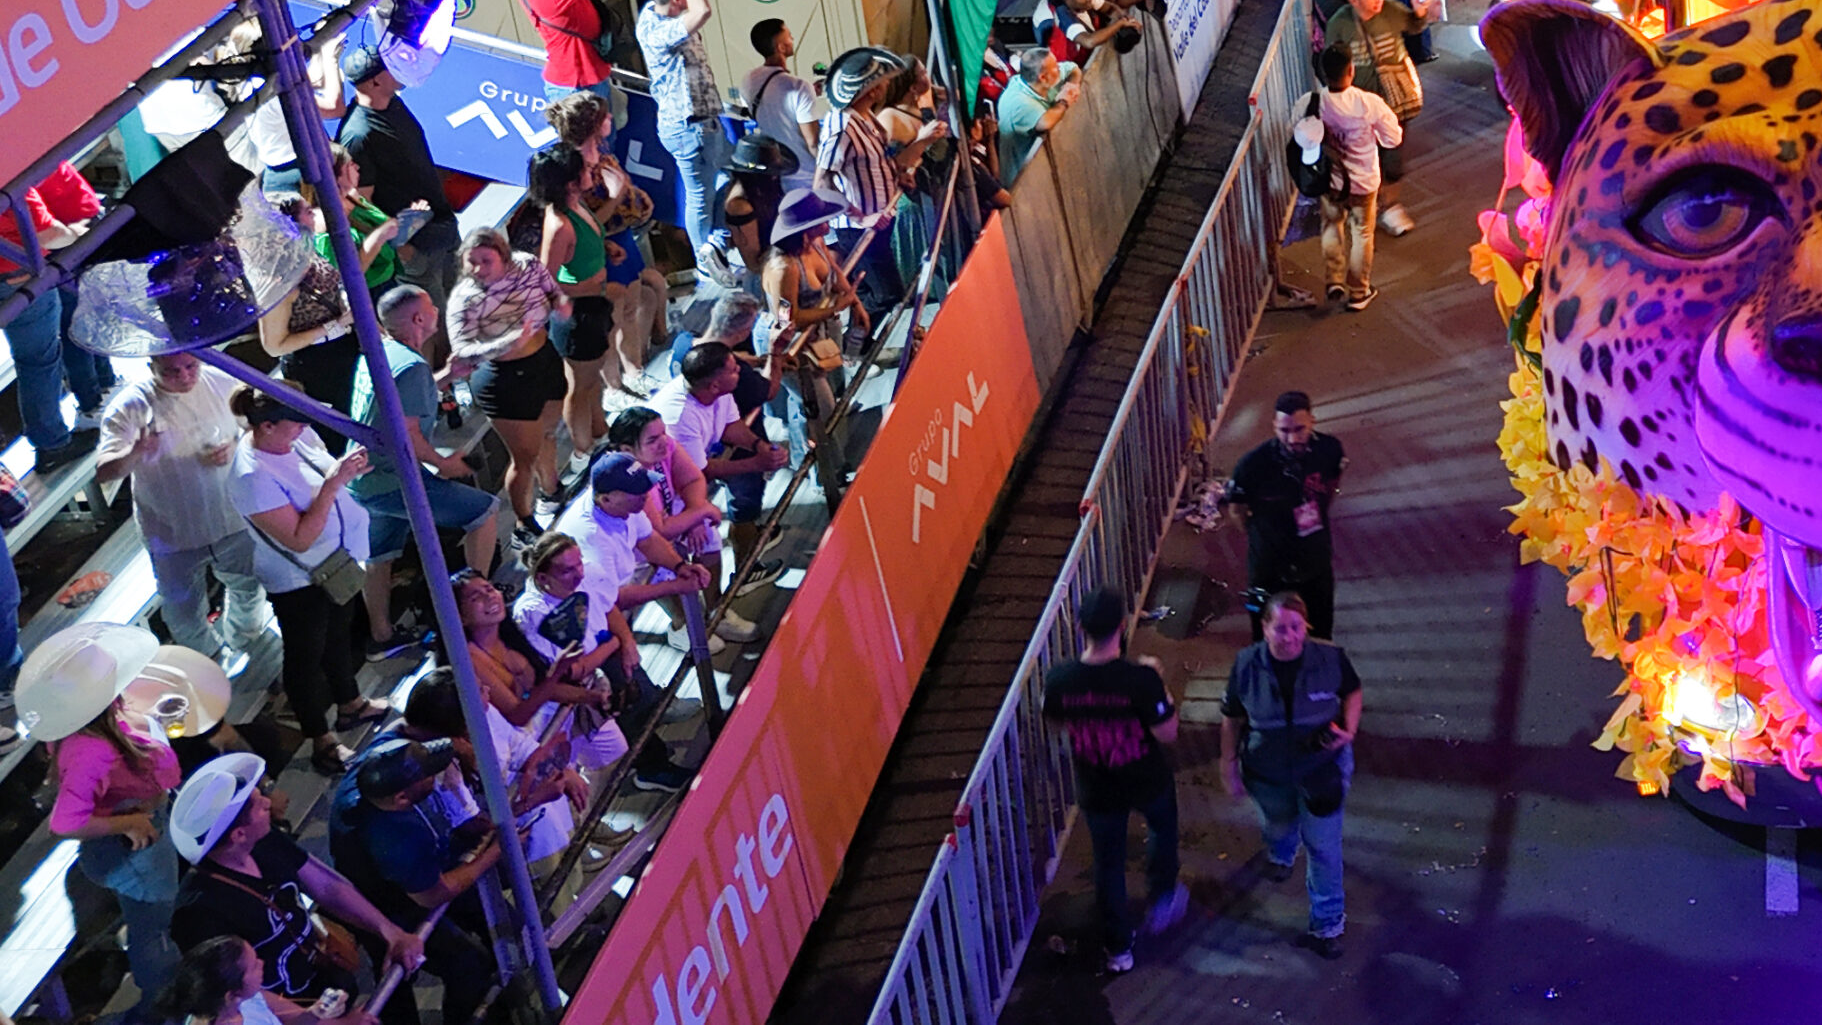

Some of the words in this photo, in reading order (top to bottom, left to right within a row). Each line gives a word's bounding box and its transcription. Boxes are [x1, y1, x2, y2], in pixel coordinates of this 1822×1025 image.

[1188, 4, 1200, 38] del
[479, 81, 548, 113] Grup
[909, 408, 942, 476] Grupo
[912, 371, 989, 543] AVAL
